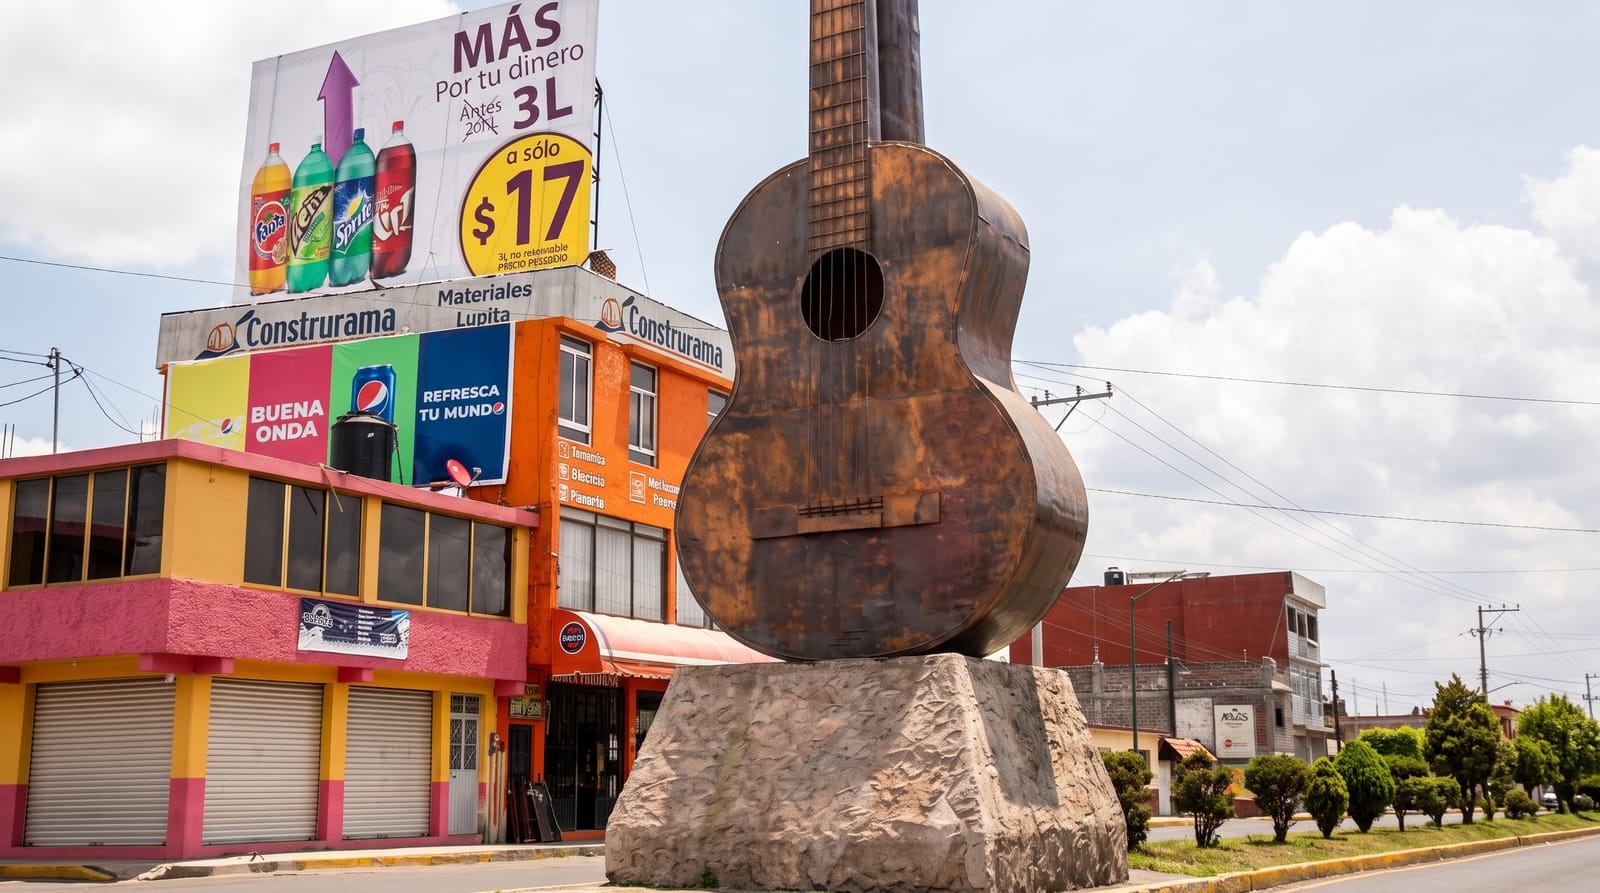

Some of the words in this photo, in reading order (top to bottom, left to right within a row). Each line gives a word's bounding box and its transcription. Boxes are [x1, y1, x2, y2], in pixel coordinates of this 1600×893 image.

[453, 1, 561, 74] MÁS
[436, 78, 472, 103] Por
[478, 69, 501, 90] tu
[509, 44, 584, 80] dinero
[460, 101, 502, 122] Antes
[513, 76, 573, 130] 3L
[506, 150, 518, 165] a
[523, 139, 560, 162] sólo
[256, 213, 286, 244] Fanta
[334, 202, 373, 250] Sprite
[510, 252, 521, 260] no
[438, 282, 532, 307] Materiales
[247, 307, 396, 347] Construrama
[457, 307, 510, 327] Lupita
[630, 304, 723, 369] Construrama
[423, 384, 500, 403] REFRESCA
[251, 400, 325, 424] BUENA
[419, 408, 440, 422] TU
[255, 420, 318, 443] ONDA
